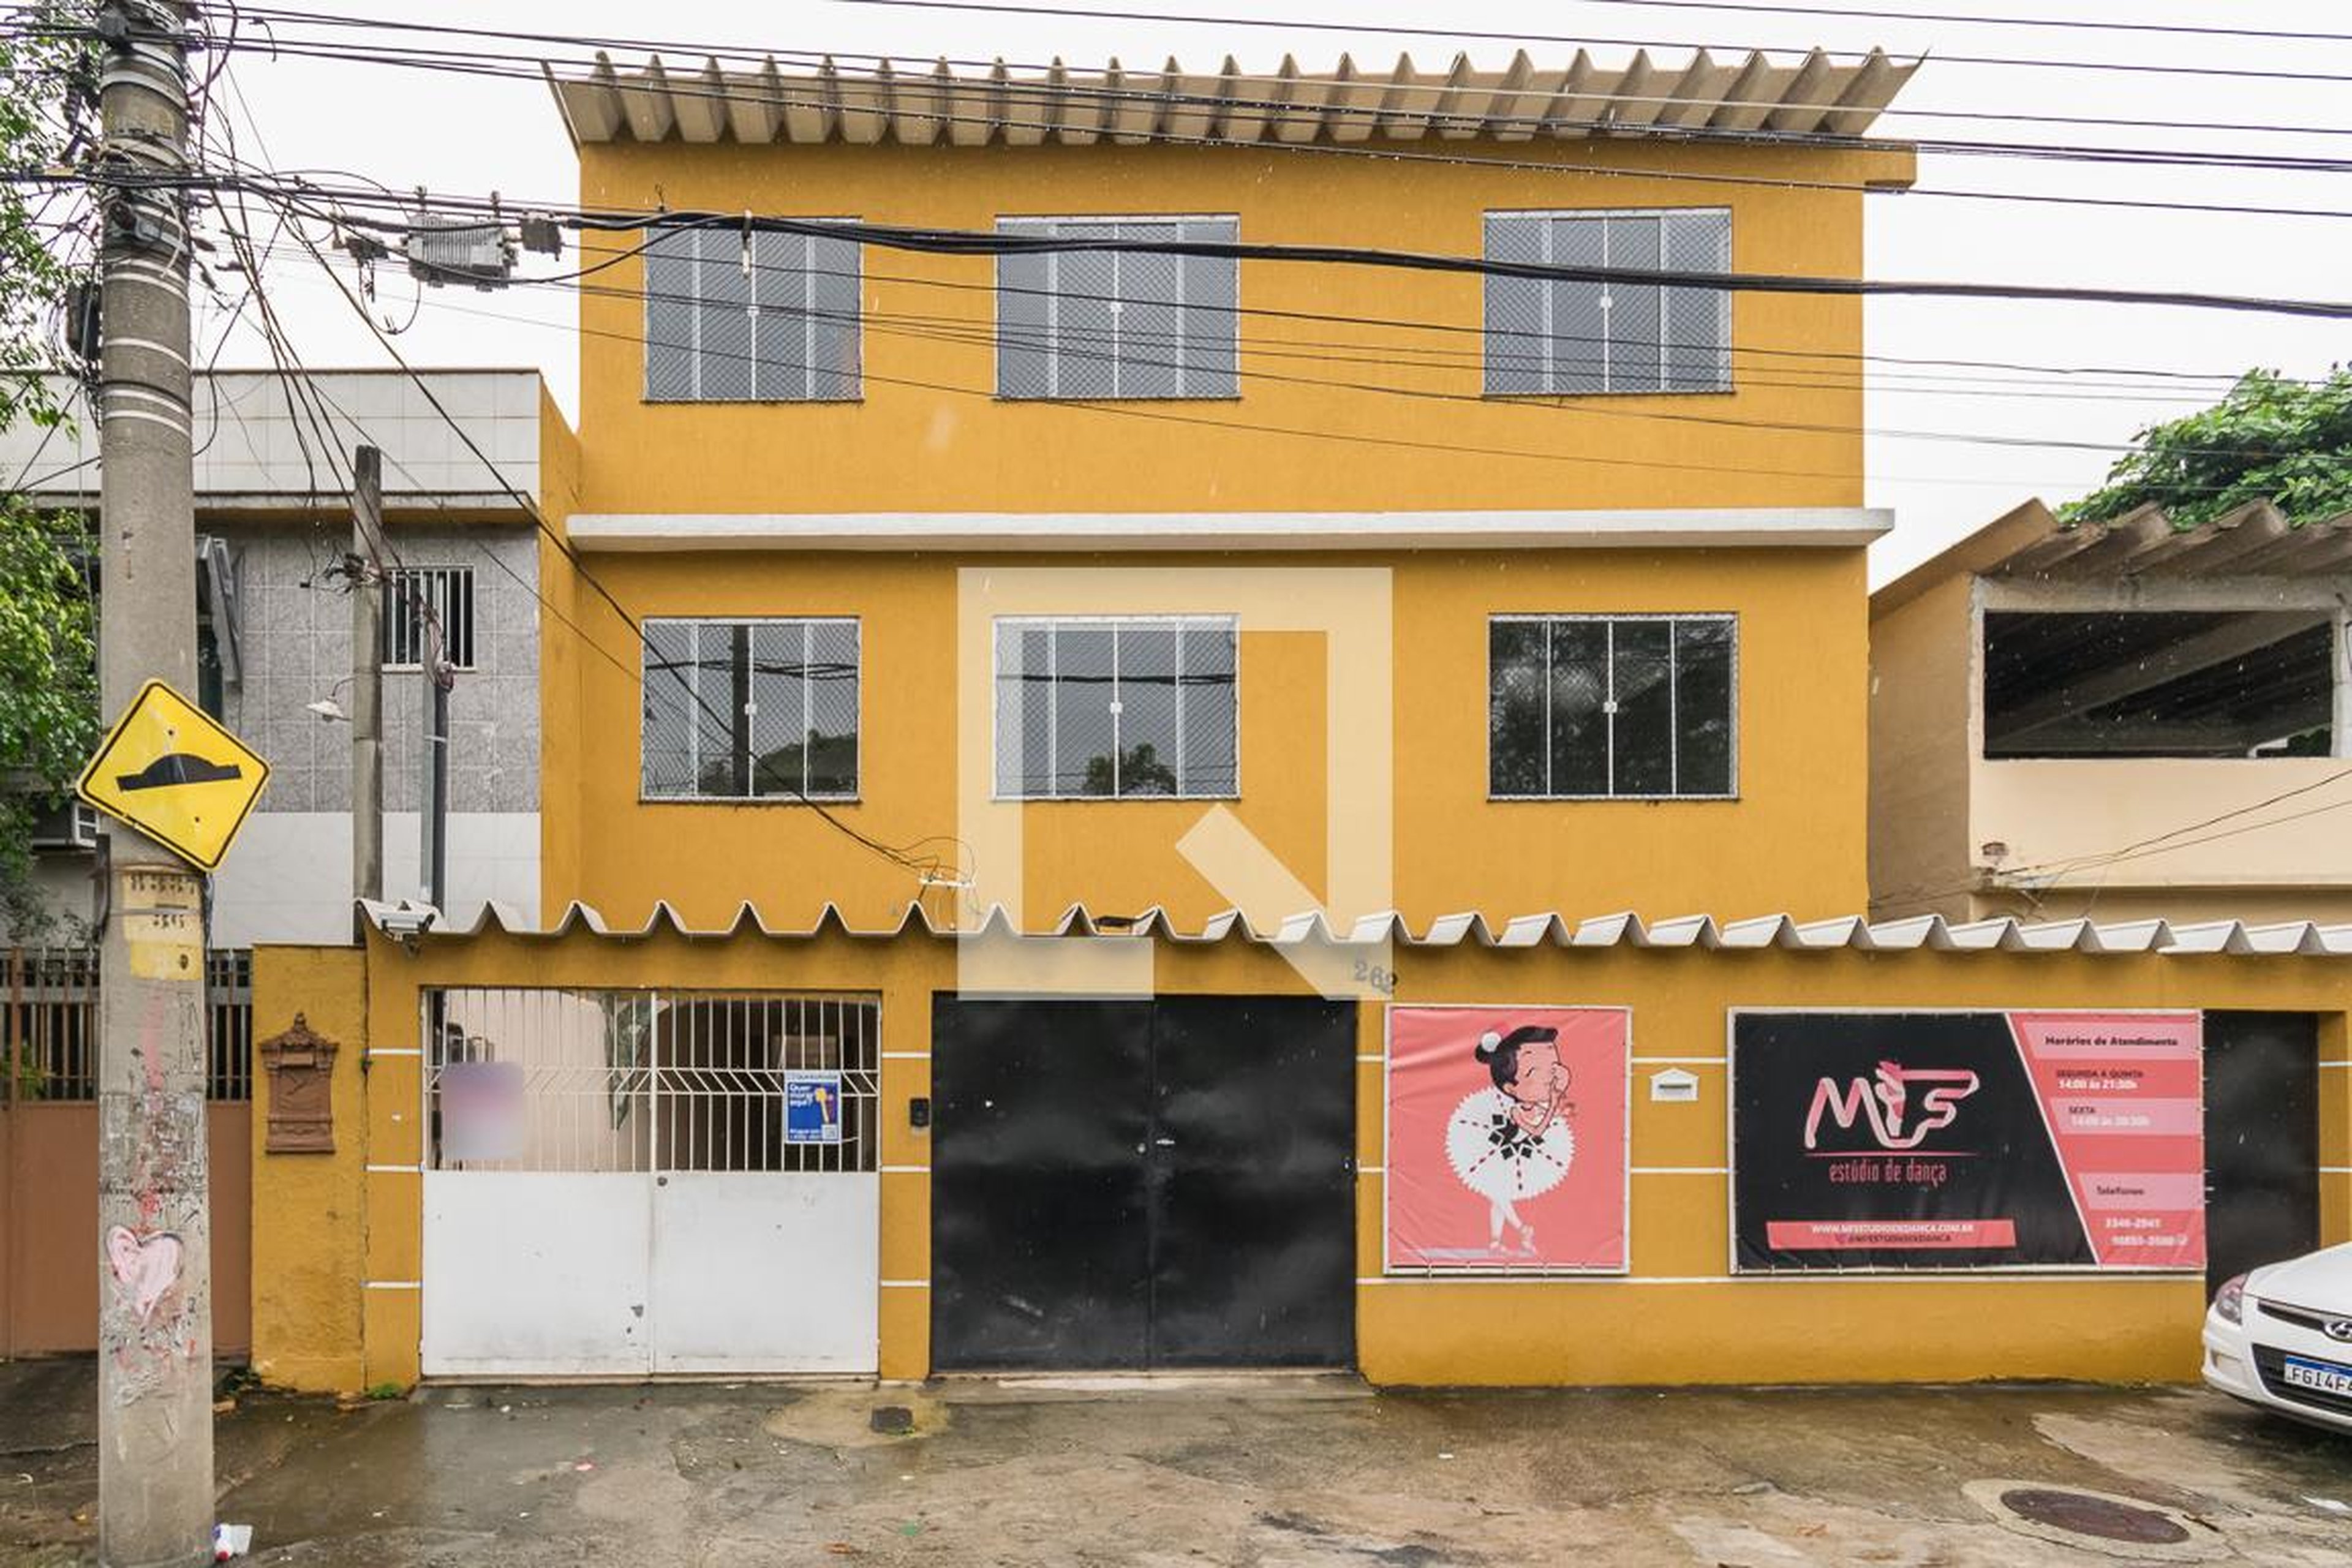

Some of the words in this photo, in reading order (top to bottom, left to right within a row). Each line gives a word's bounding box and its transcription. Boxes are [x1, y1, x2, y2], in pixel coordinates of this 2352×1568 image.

[1829, 1159, 1879, 1182] estúdio
[1885, 1159, 1902, 1182] de
[1905, 1158, 1947, 1187] dança
